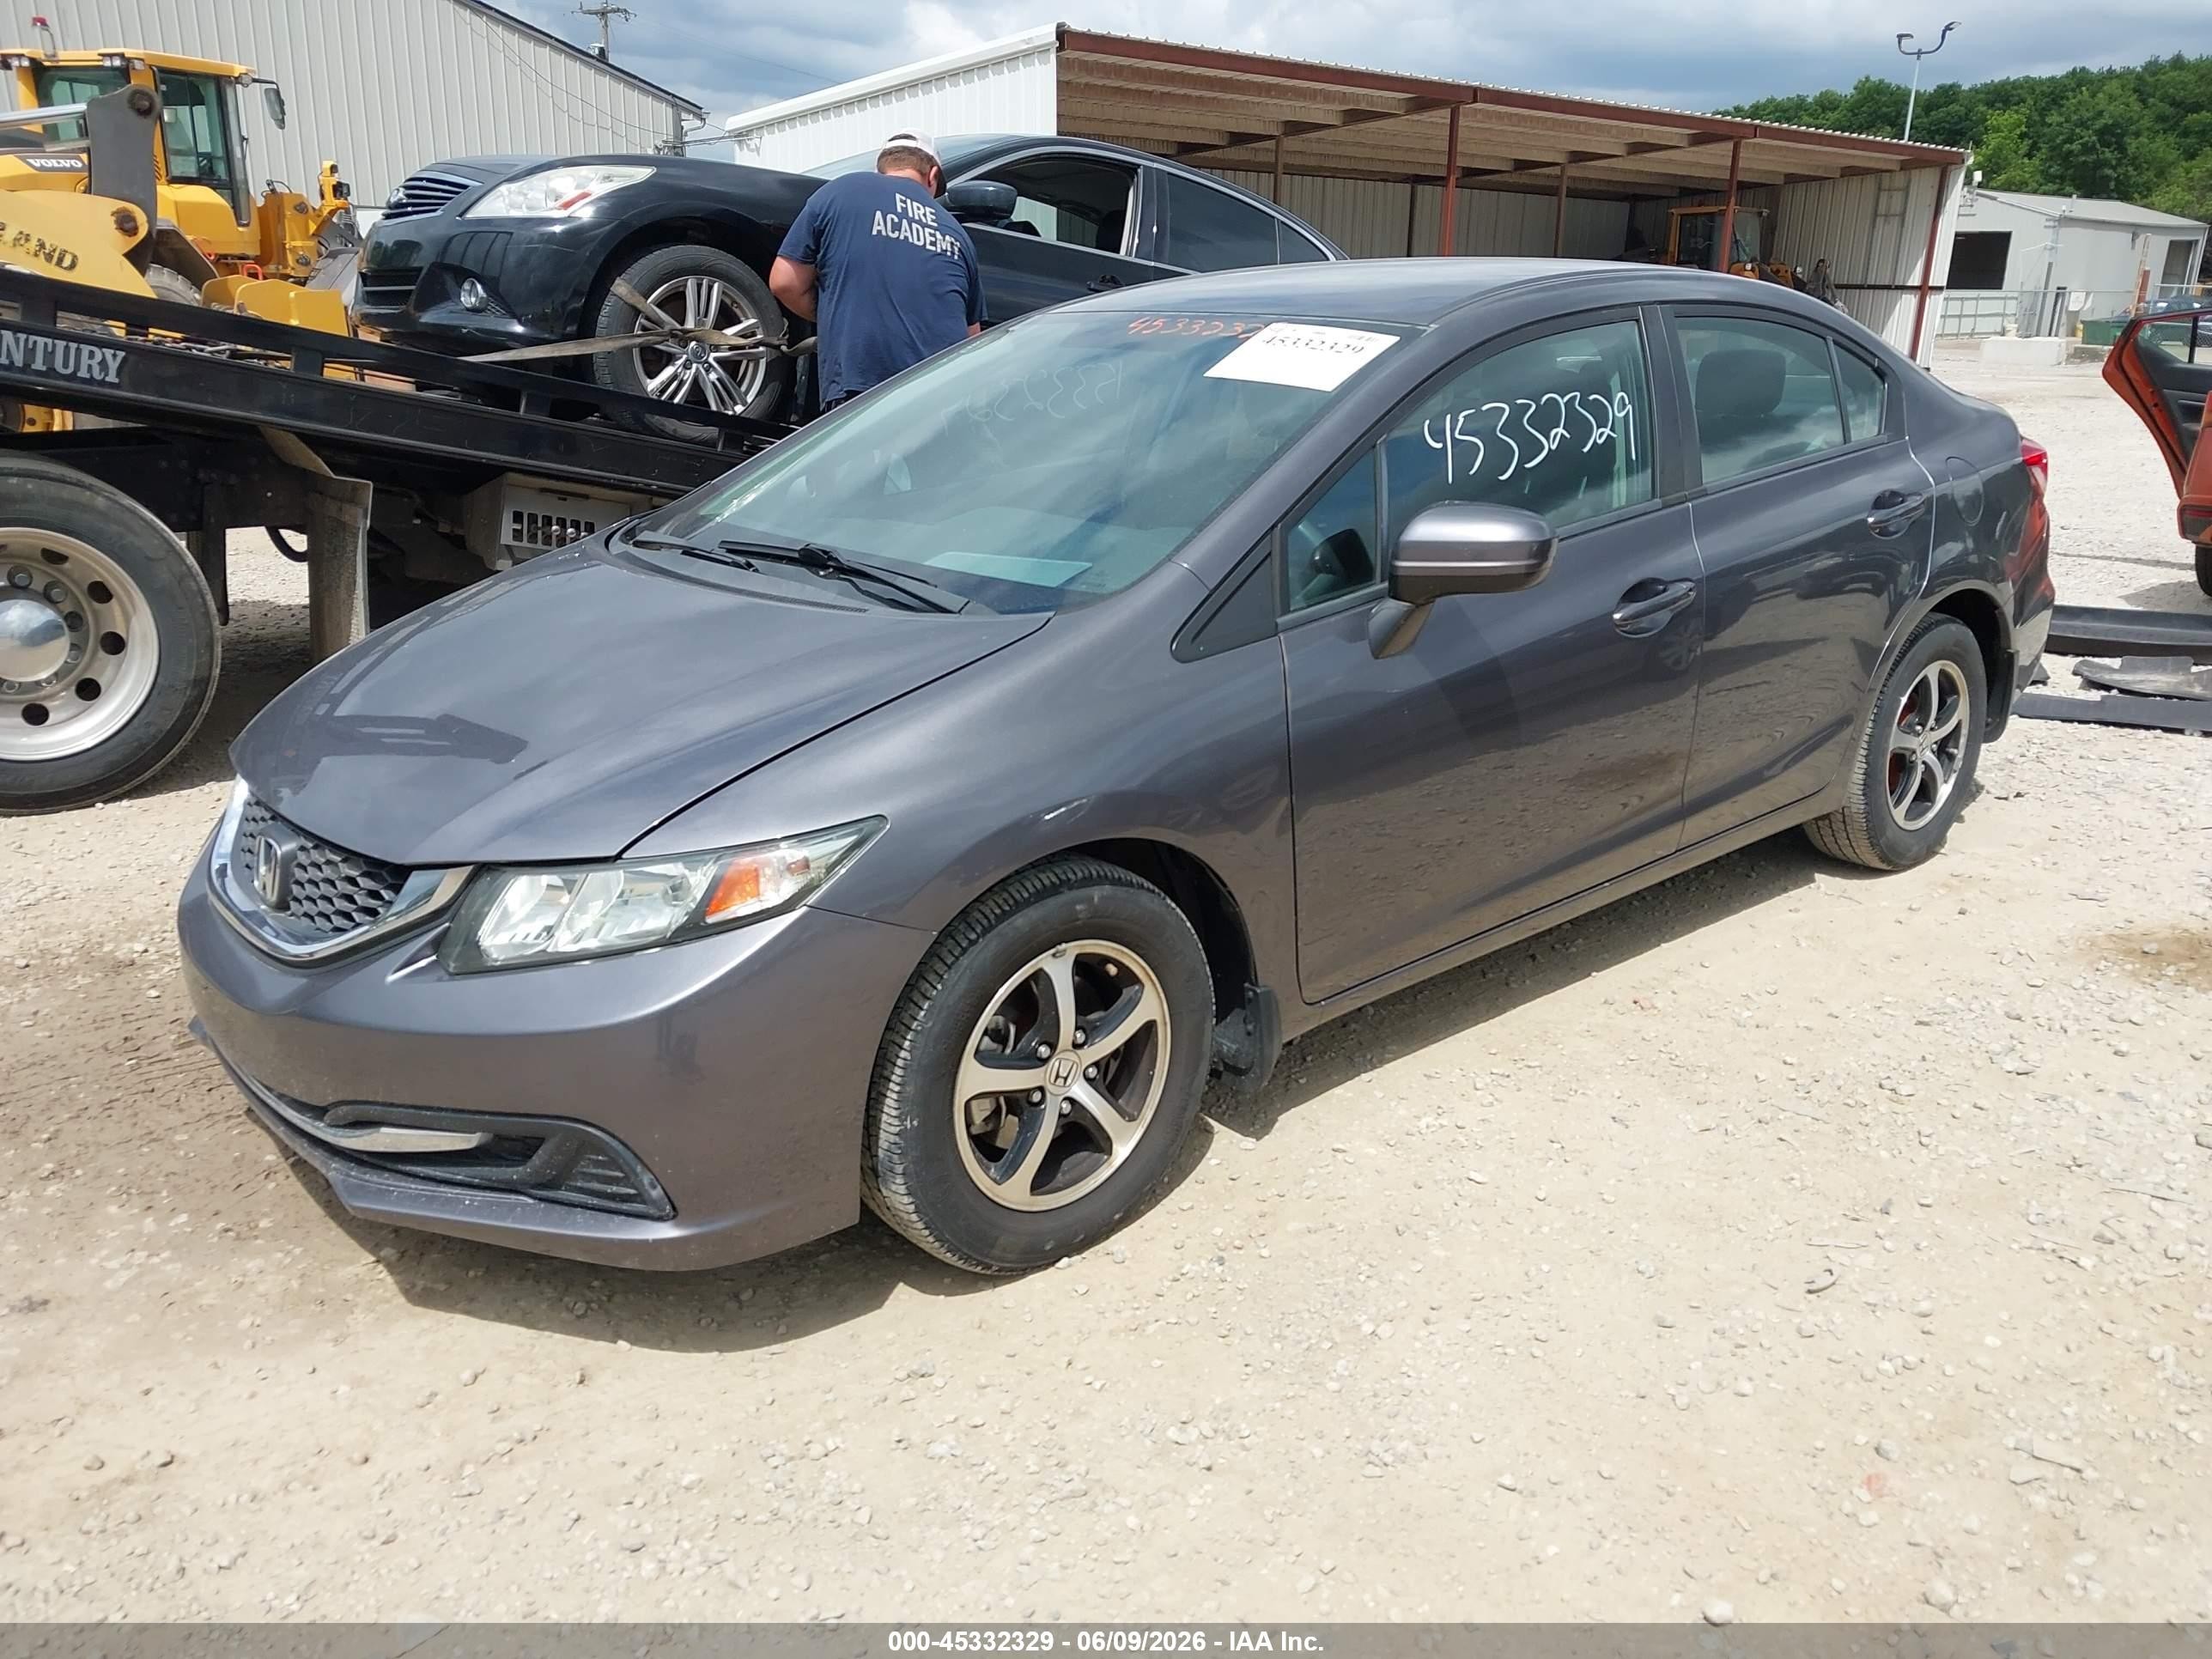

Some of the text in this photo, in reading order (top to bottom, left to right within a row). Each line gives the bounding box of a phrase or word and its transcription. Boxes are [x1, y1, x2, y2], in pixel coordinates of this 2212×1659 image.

[26, 158, 83, 168] VOLVO
[895, 191, 938, 228] FIRE
[872, 210, 961, 260] ACADEMY
[1127, 316, 1266, 339] 4533232
[1423, 391, 1637, 485] 45332329
